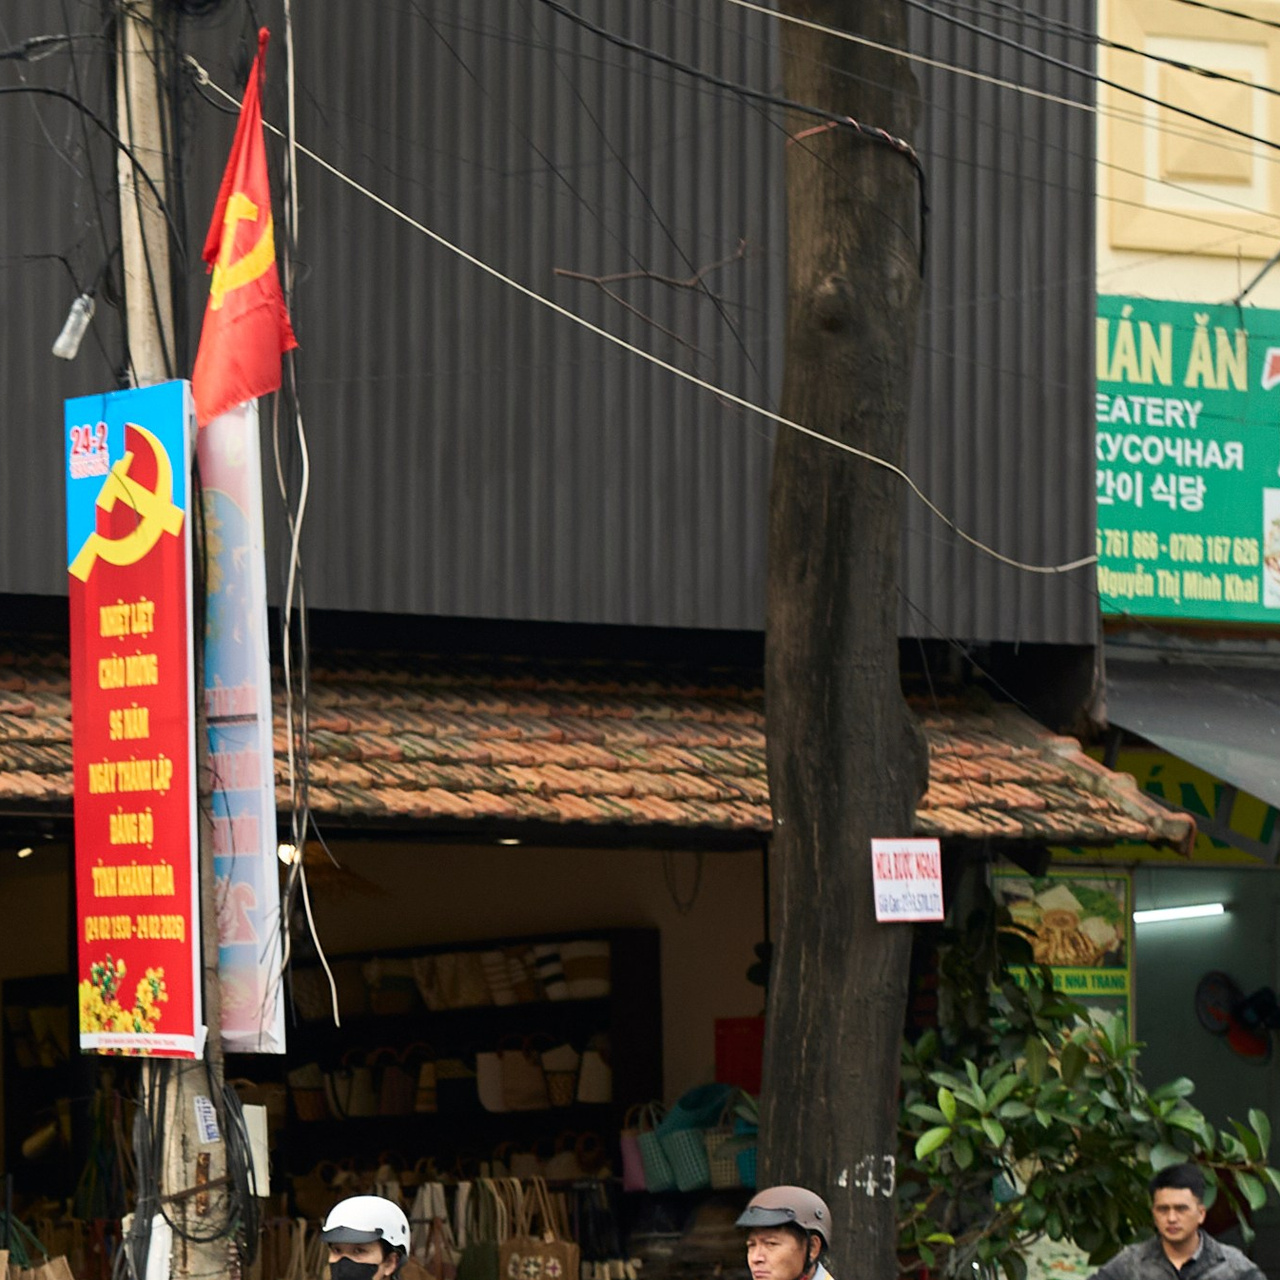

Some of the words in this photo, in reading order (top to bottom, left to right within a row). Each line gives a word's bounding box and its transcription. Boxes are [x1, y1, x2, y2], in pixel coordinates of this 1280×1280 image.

[1183, 312, 1249, 392] ĂN
[1096, 393, 1203, 429] EATERY
[1150, 473, 1207, 512] 식당
[1183, 570, 1222, 602] Minh
[1224, 573, 1259, 603] Khai
